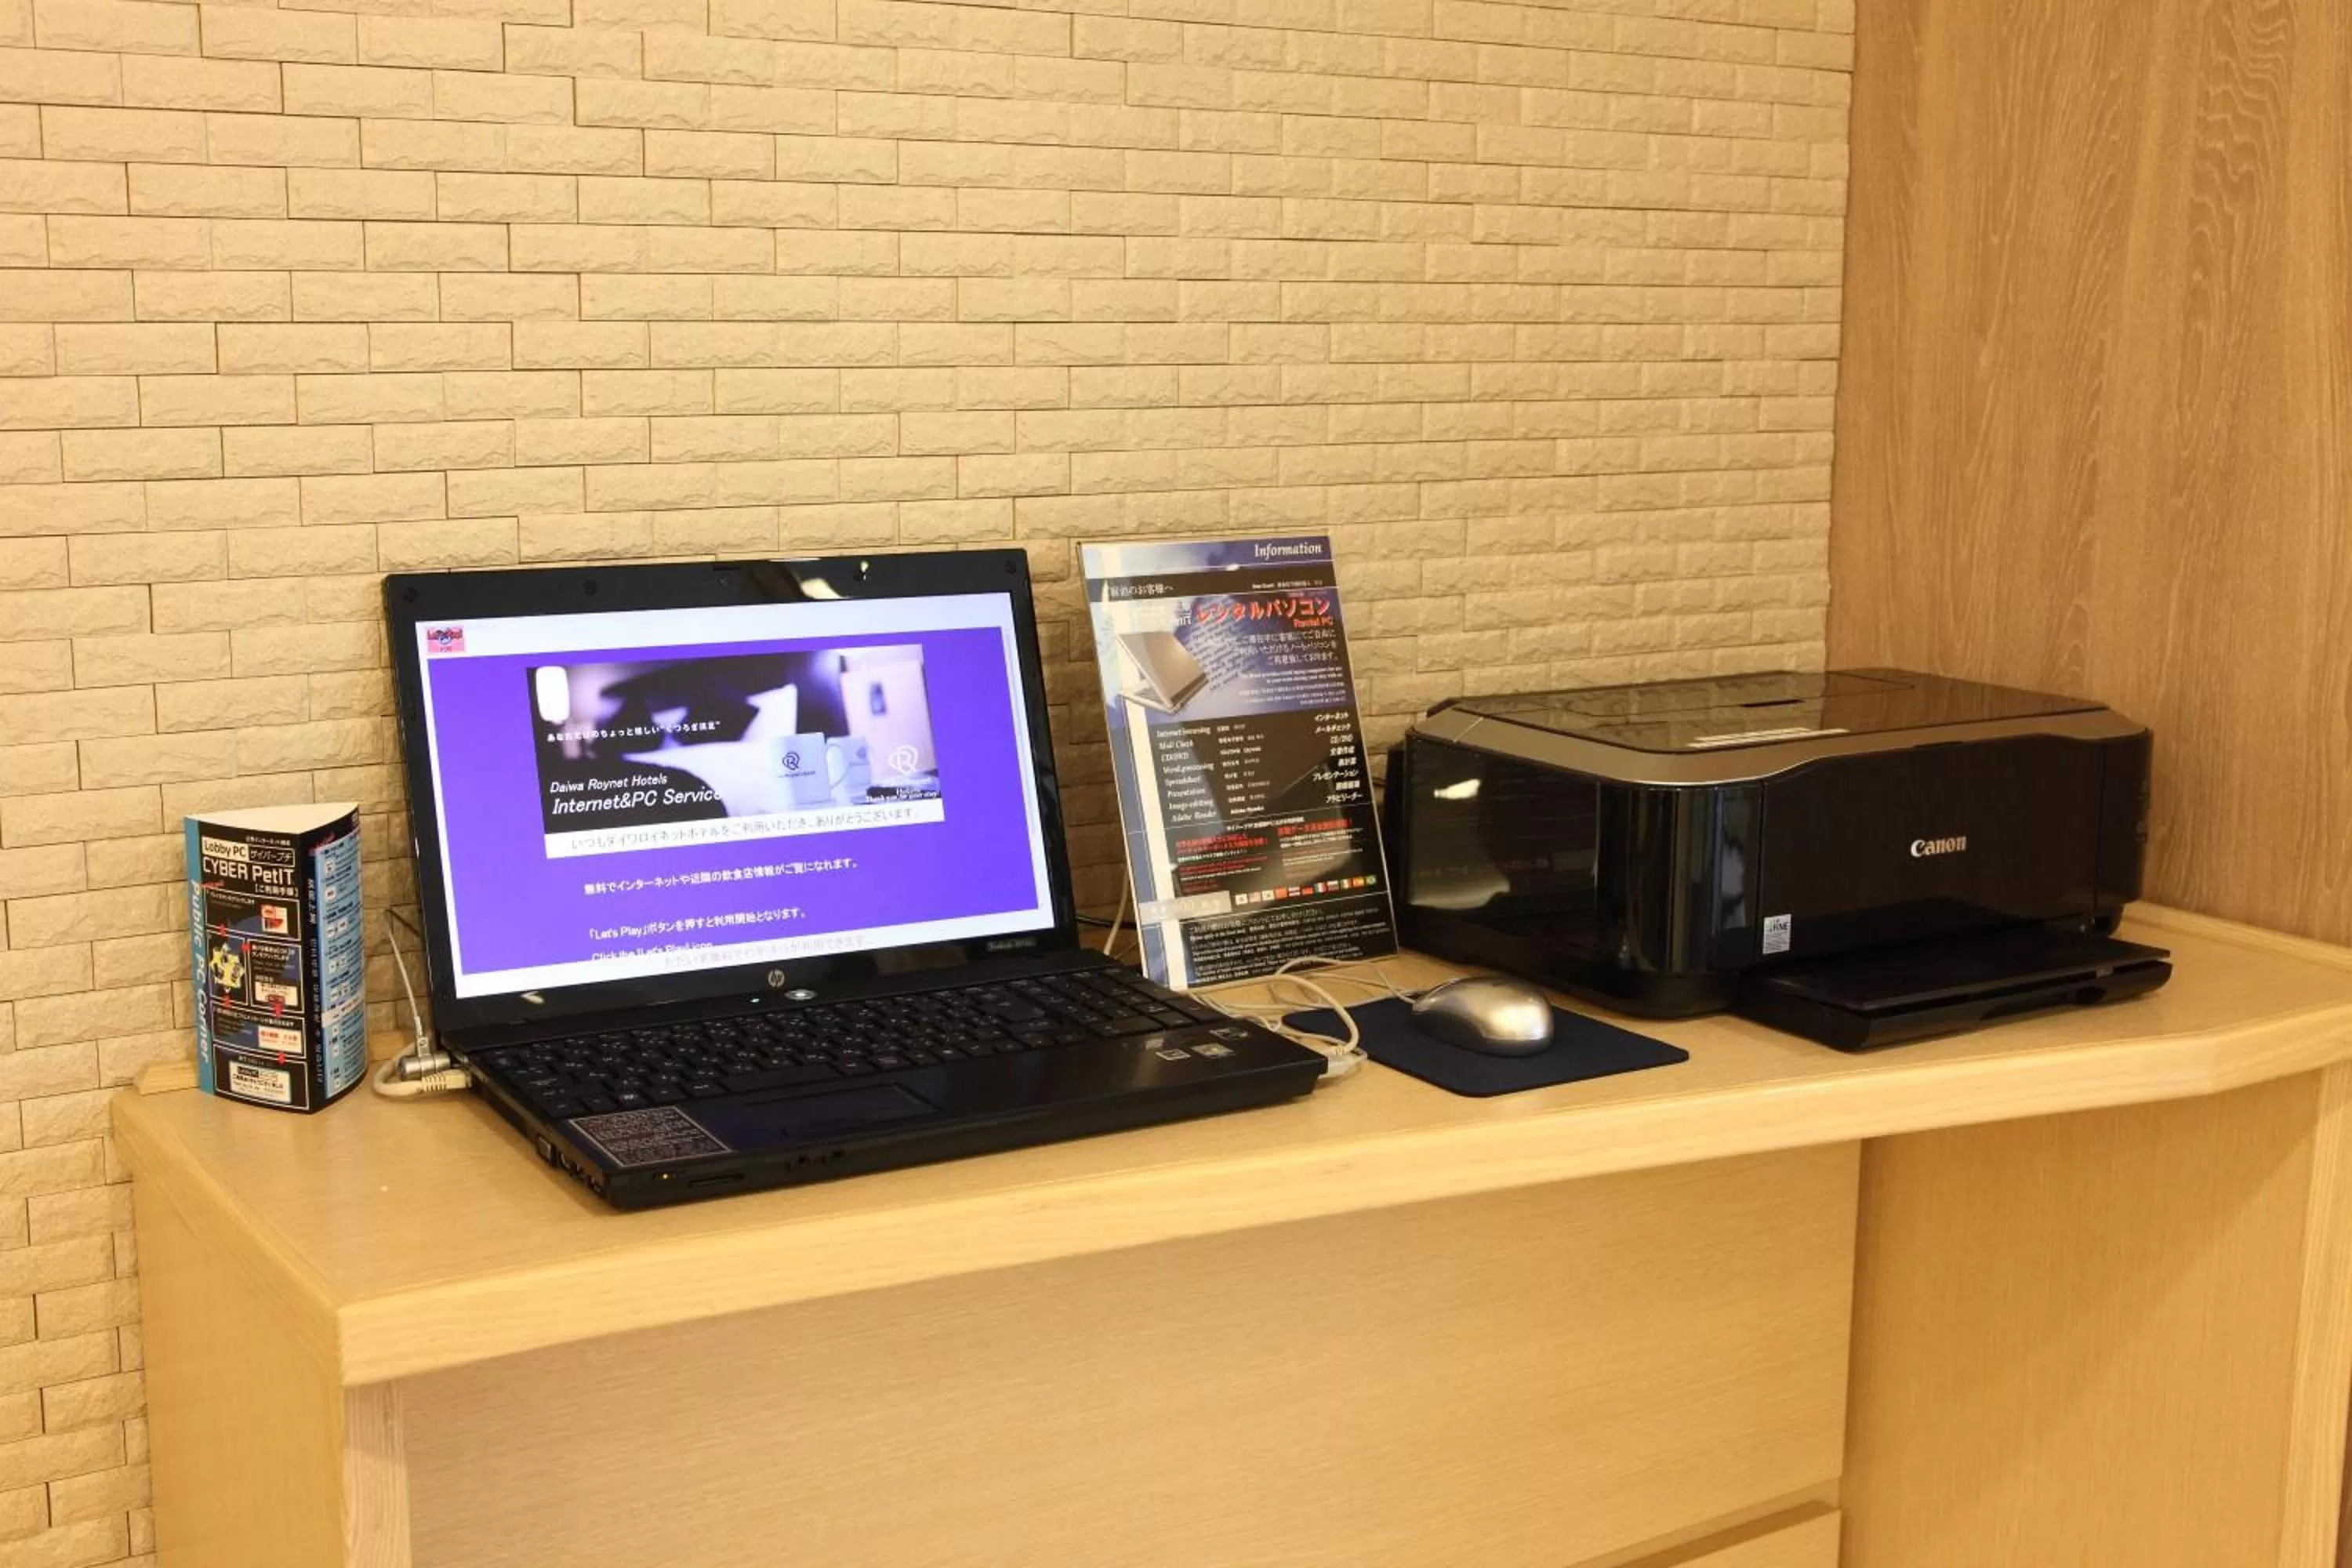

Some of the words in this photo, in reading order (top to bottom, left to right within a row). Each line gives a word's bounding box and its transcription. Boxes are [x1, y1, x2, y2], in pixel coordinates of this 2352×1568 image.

[1254, 541, 1323, 561] Information
[1196, 598, 1330, 626] レンタルパソコン
[550, 780, 584, 793] Daiwa
[587, 777, 627, 792] Roynet
[630, 772, 668, 787] Hotels
[552, 789, 658, 815] Internet&PC
[662, 785, 722, 804] Service
[204, 840, 231, 858] Lobby
[233, 845, 247, 858] PC
[1910, 835, 1967, 858] Canon
[203, 856, 249, 880] CYBER
[252, 865, 295, 885] PetIT
[191, 878, 203, 948] Public
[195, 953, 206, 984] PC
[198, 988, 209, 1064] Corner
